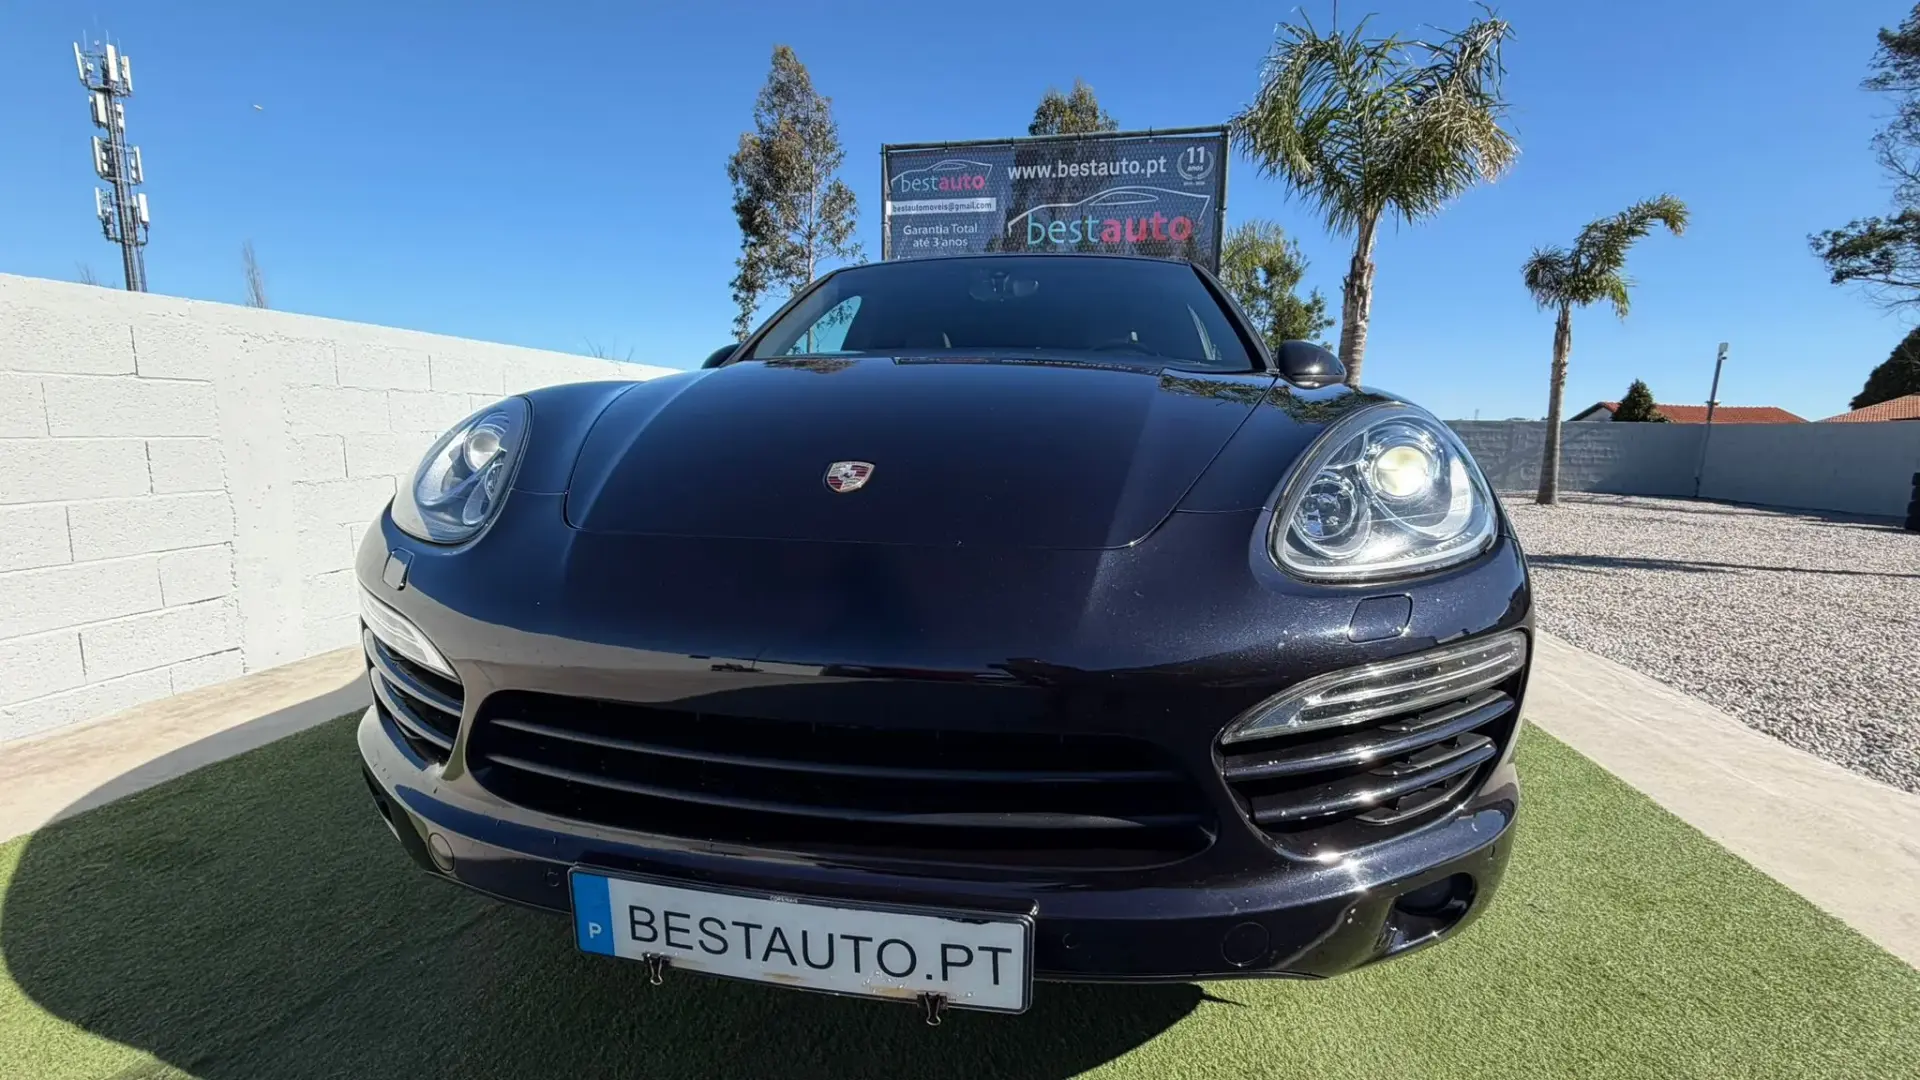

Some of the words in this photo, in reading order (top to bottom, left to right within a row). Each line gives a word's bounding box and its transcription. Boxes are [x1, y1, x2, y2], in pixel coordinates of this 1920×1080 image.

[1187, 146, 1205, 163] 11
[1008, 155, 1167, 180] www.bestauto.pt
[901, 173, 986, 193] bestauto
[892, 201, 992, 213] bestautomoveis@gmail.com
[903, 224, 950, 235] Garantia
[951, 222, 978, 233] Total
[1027, 211, 1192, 245] bestauto
[912, 238, 929, 248] até
[932, 237, 939, 247] 3
[941, 238, 968, 247] anos
[588, 921, 602, 939] P
[628, 904, 1012, 986] BESTAUTO.PT
